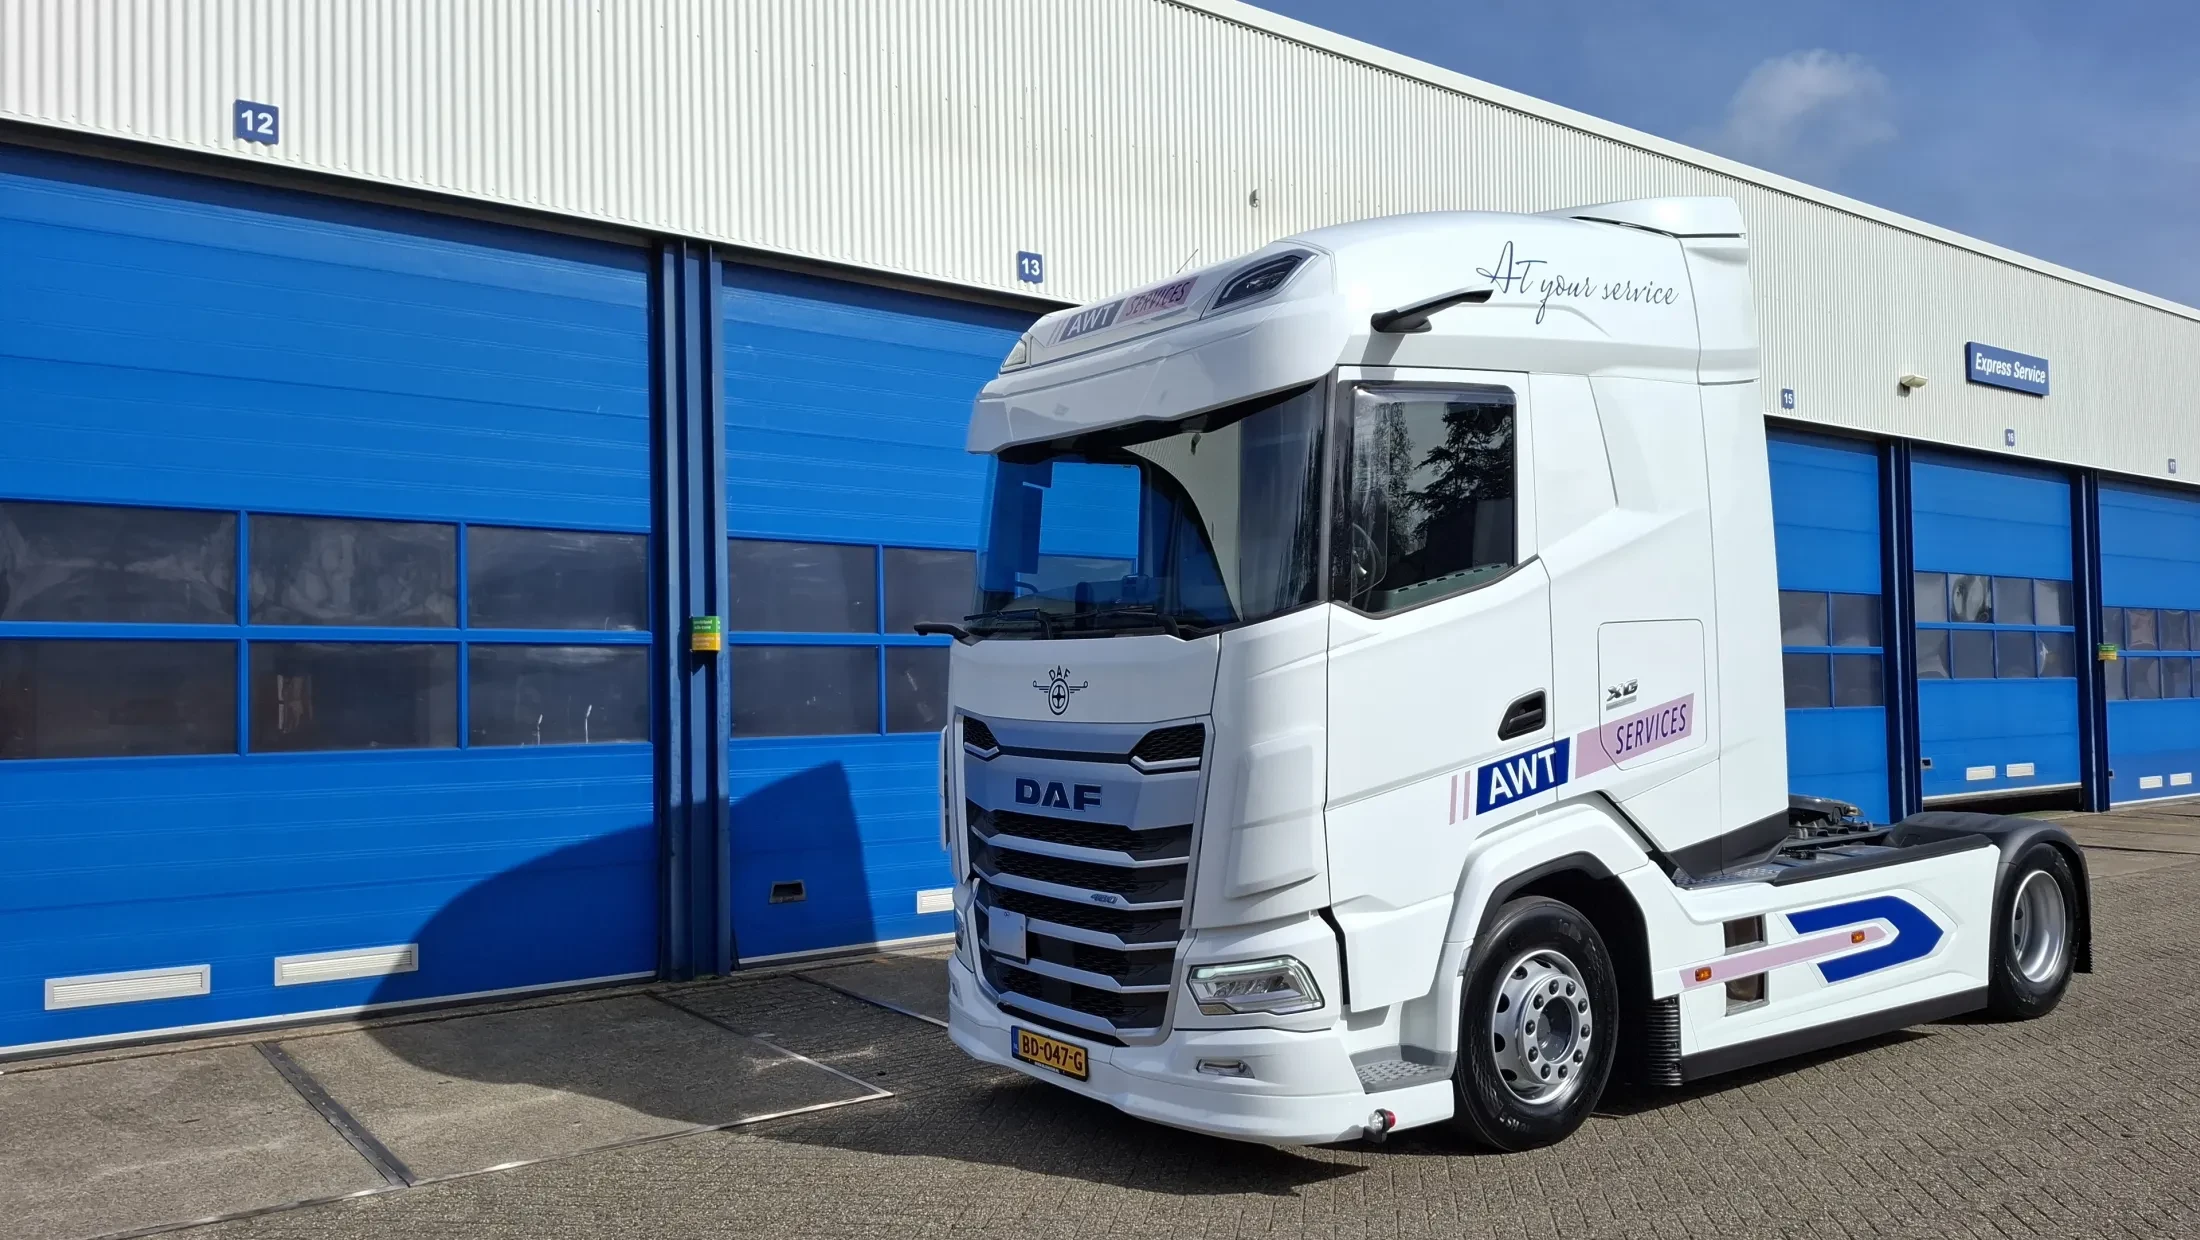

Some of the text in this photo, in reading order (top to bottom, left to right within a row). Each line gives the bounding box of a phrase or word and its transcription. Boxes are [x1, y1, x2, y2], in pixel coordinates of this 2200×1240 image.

[241, 109, 274, 135] 12
[1021, 257, 1041, 276] 13
[1067, 281, 1191, 337] AWT SERVICES
[1535, 275, 1598, 325] your
[1601, 281, 1680, 305] service
[1975, 352, 2046, 384] Express Service
[1784, 392, 1793, 405] 15
[1048, 665, 1071, 681] DAF
[1606, 679, 1638, 702] XG
[1489, 703, 1687, 805] AWT SERVICES
[1015, 777, 1102, 812] DAF
[1022, 1034, 1083, 1071] BD-047-G
